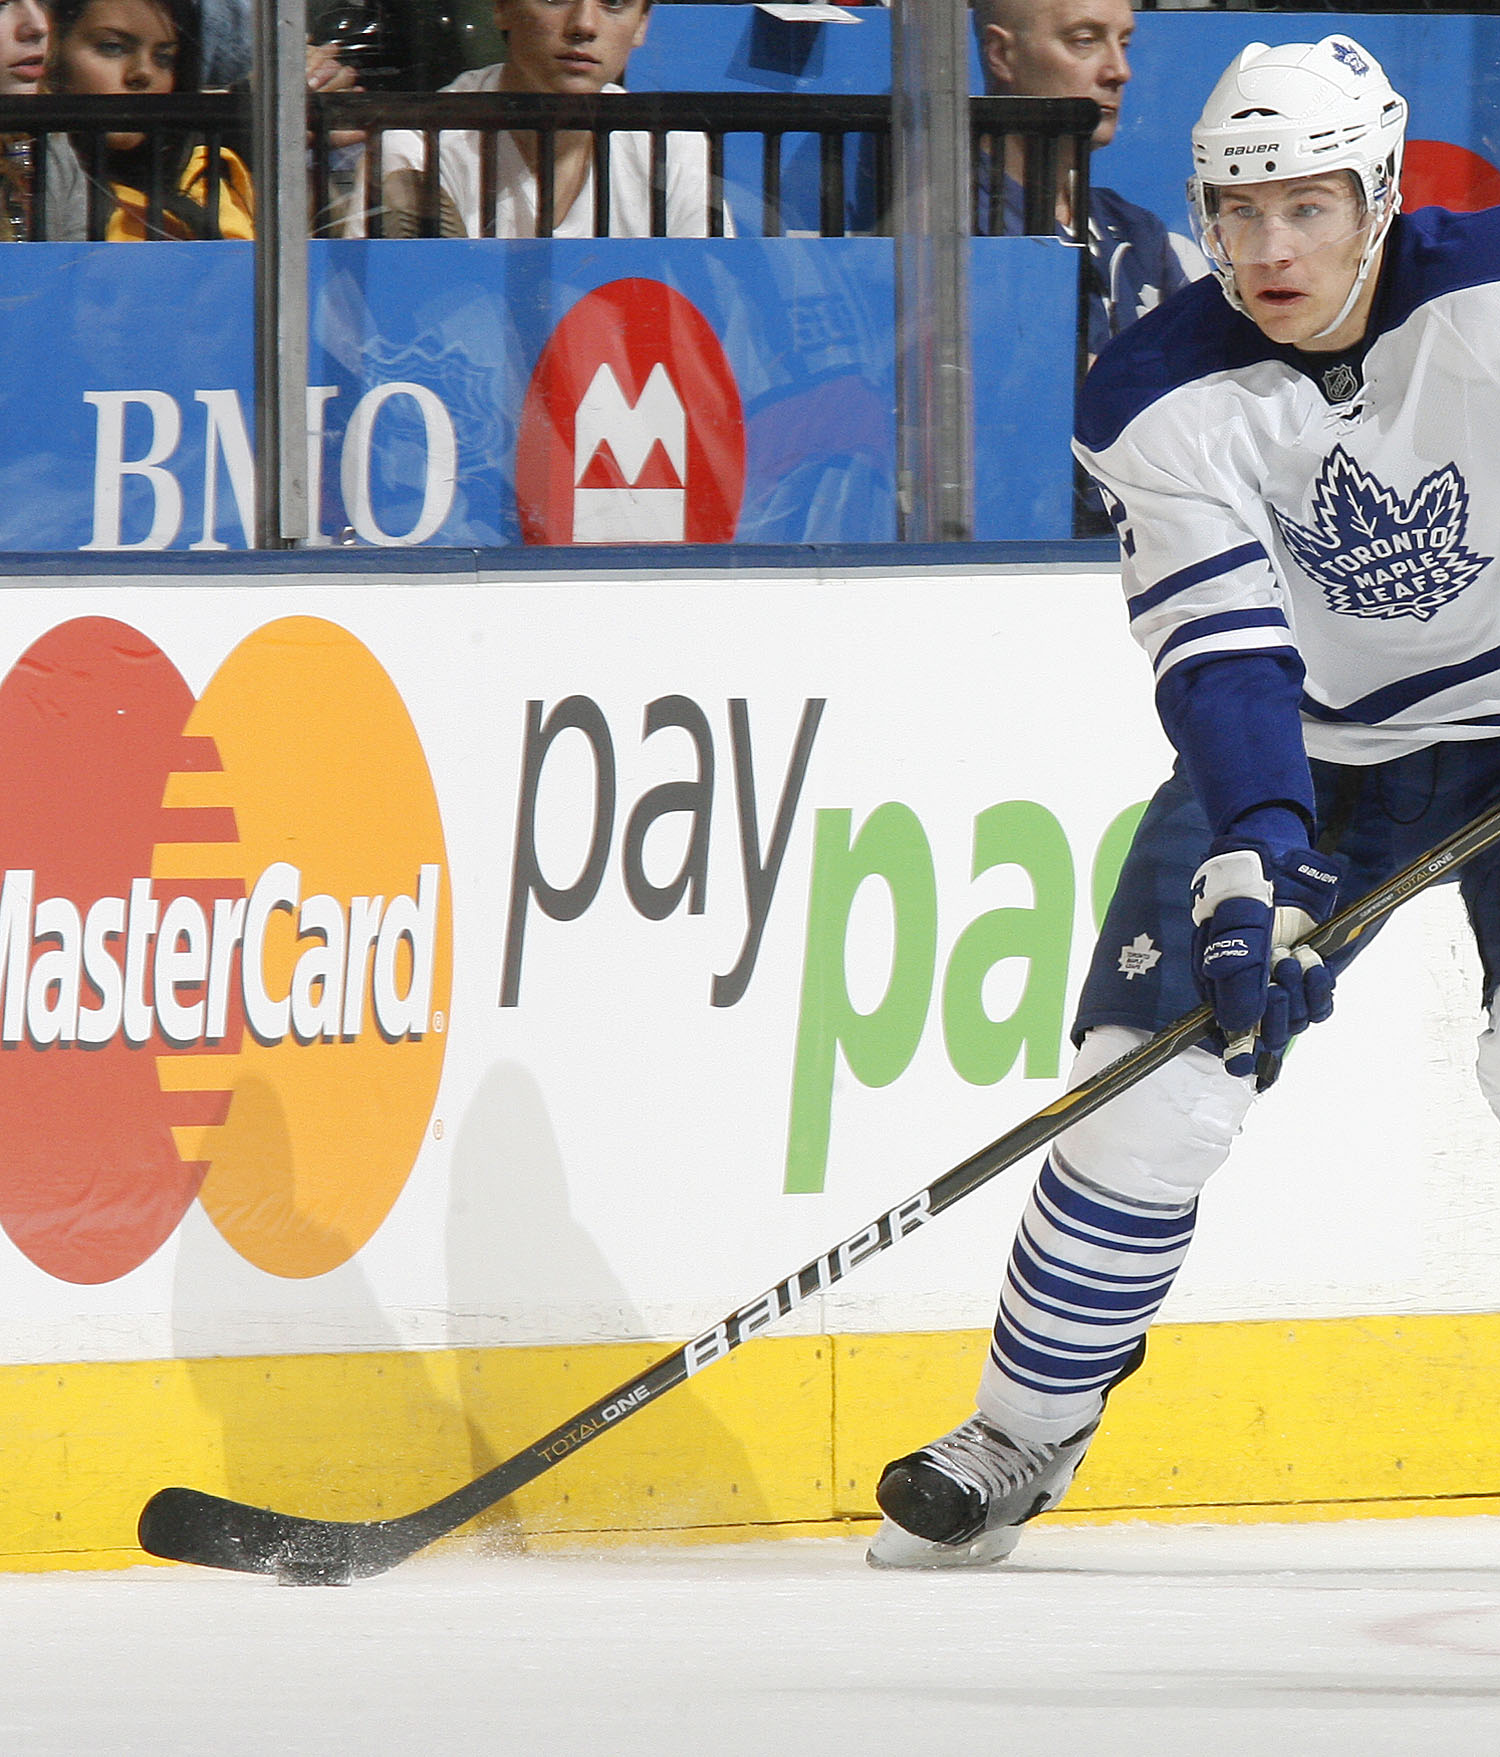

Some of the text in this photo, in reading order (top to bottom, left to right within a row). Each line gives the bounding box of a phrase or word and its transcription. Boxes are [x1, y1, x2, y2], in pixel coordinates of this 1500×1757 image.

[1224, 143, 1280, 156] BAUER
[1320, 526, 1449, 577] TORONTO
[1353, 551, 1439, 589] MAPLE
[1356, 567, 1450, 606] LEAFS
[499, 695, 826, 1007] pay
